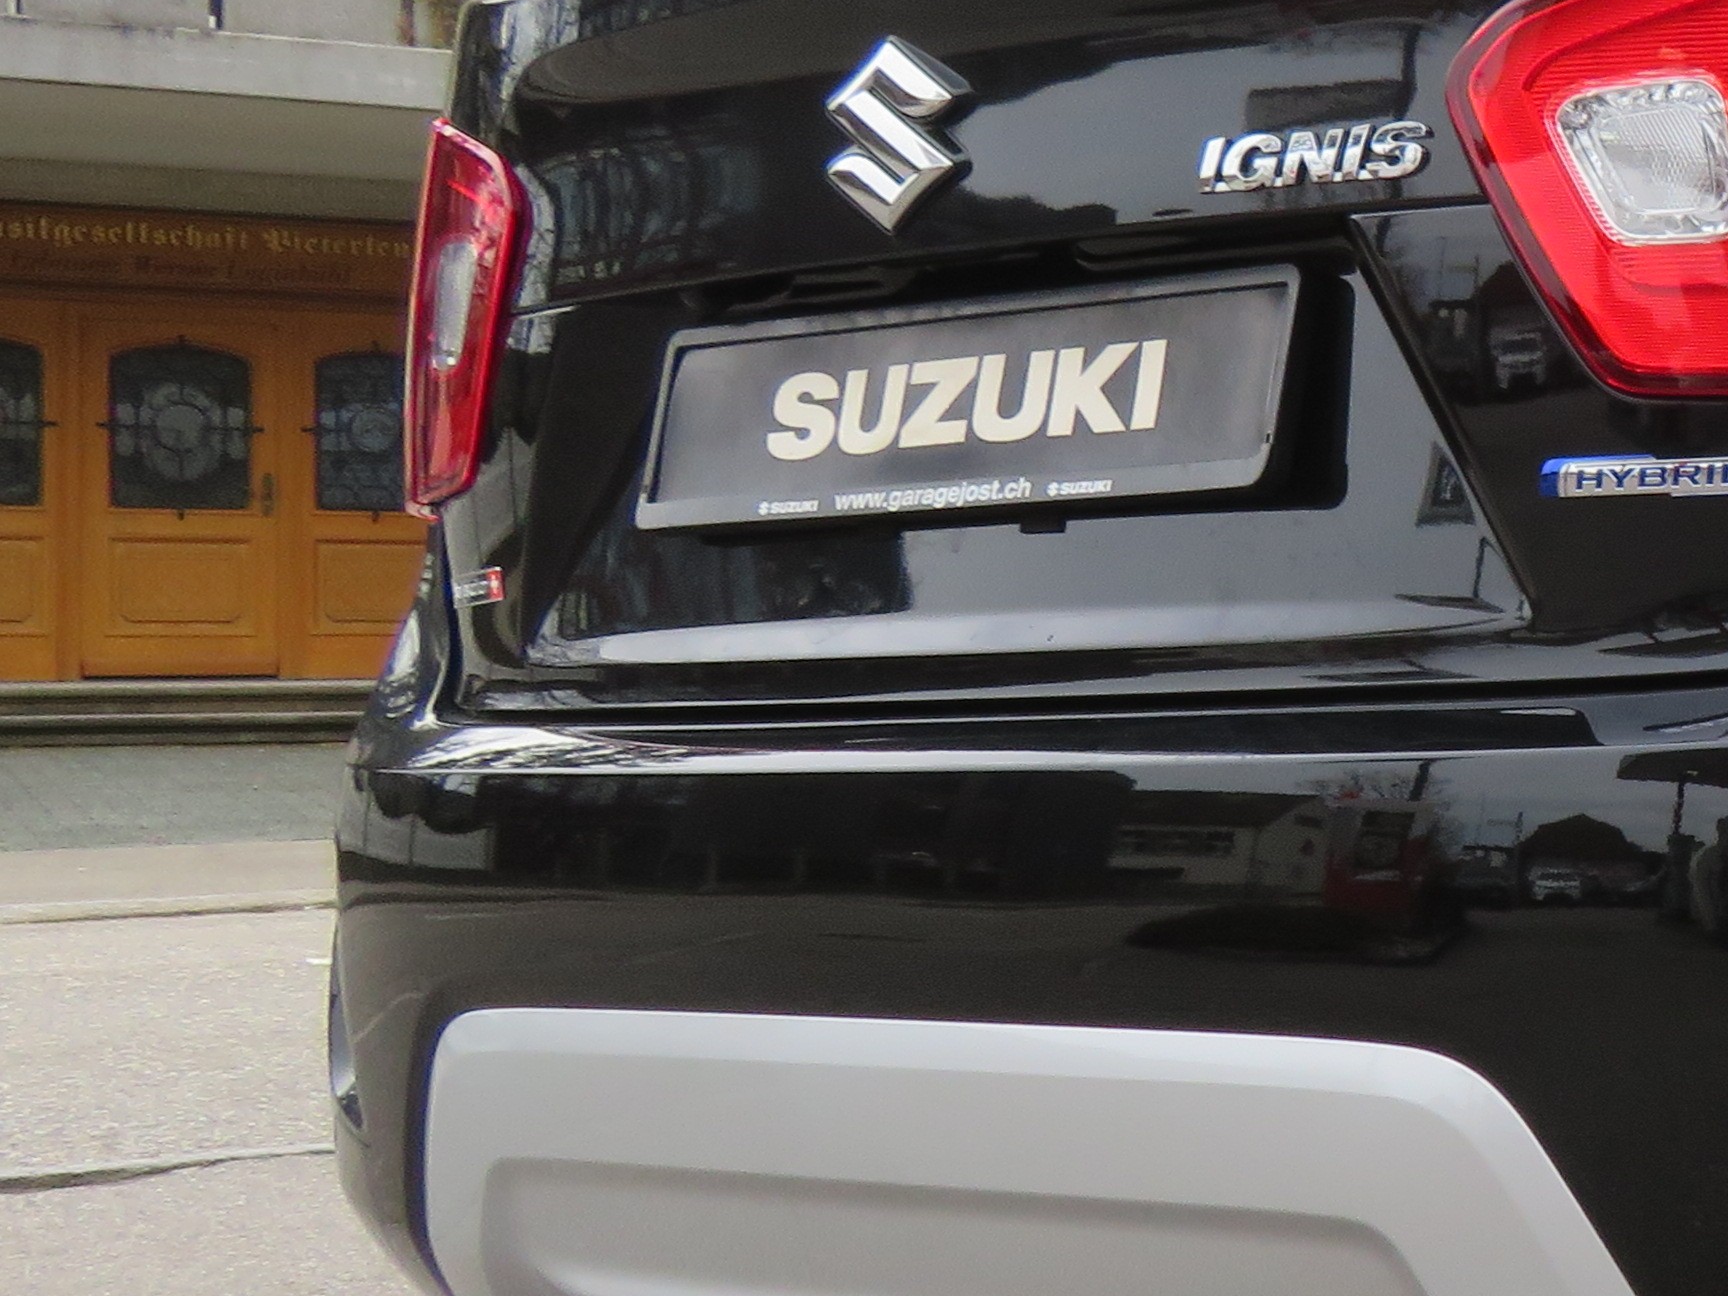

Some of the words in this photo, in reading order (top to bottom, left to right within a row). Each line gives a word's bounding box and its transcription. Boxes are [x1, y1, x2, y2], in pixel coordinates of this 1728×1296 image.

[1198, 121, 1431, 193] IGNIS
[766, 339, 1168, 461] SUZUKI
[834, 477, 1032, 512] www.garagejost.ch
[1060, 479, 1113, 495] SUZUKI
